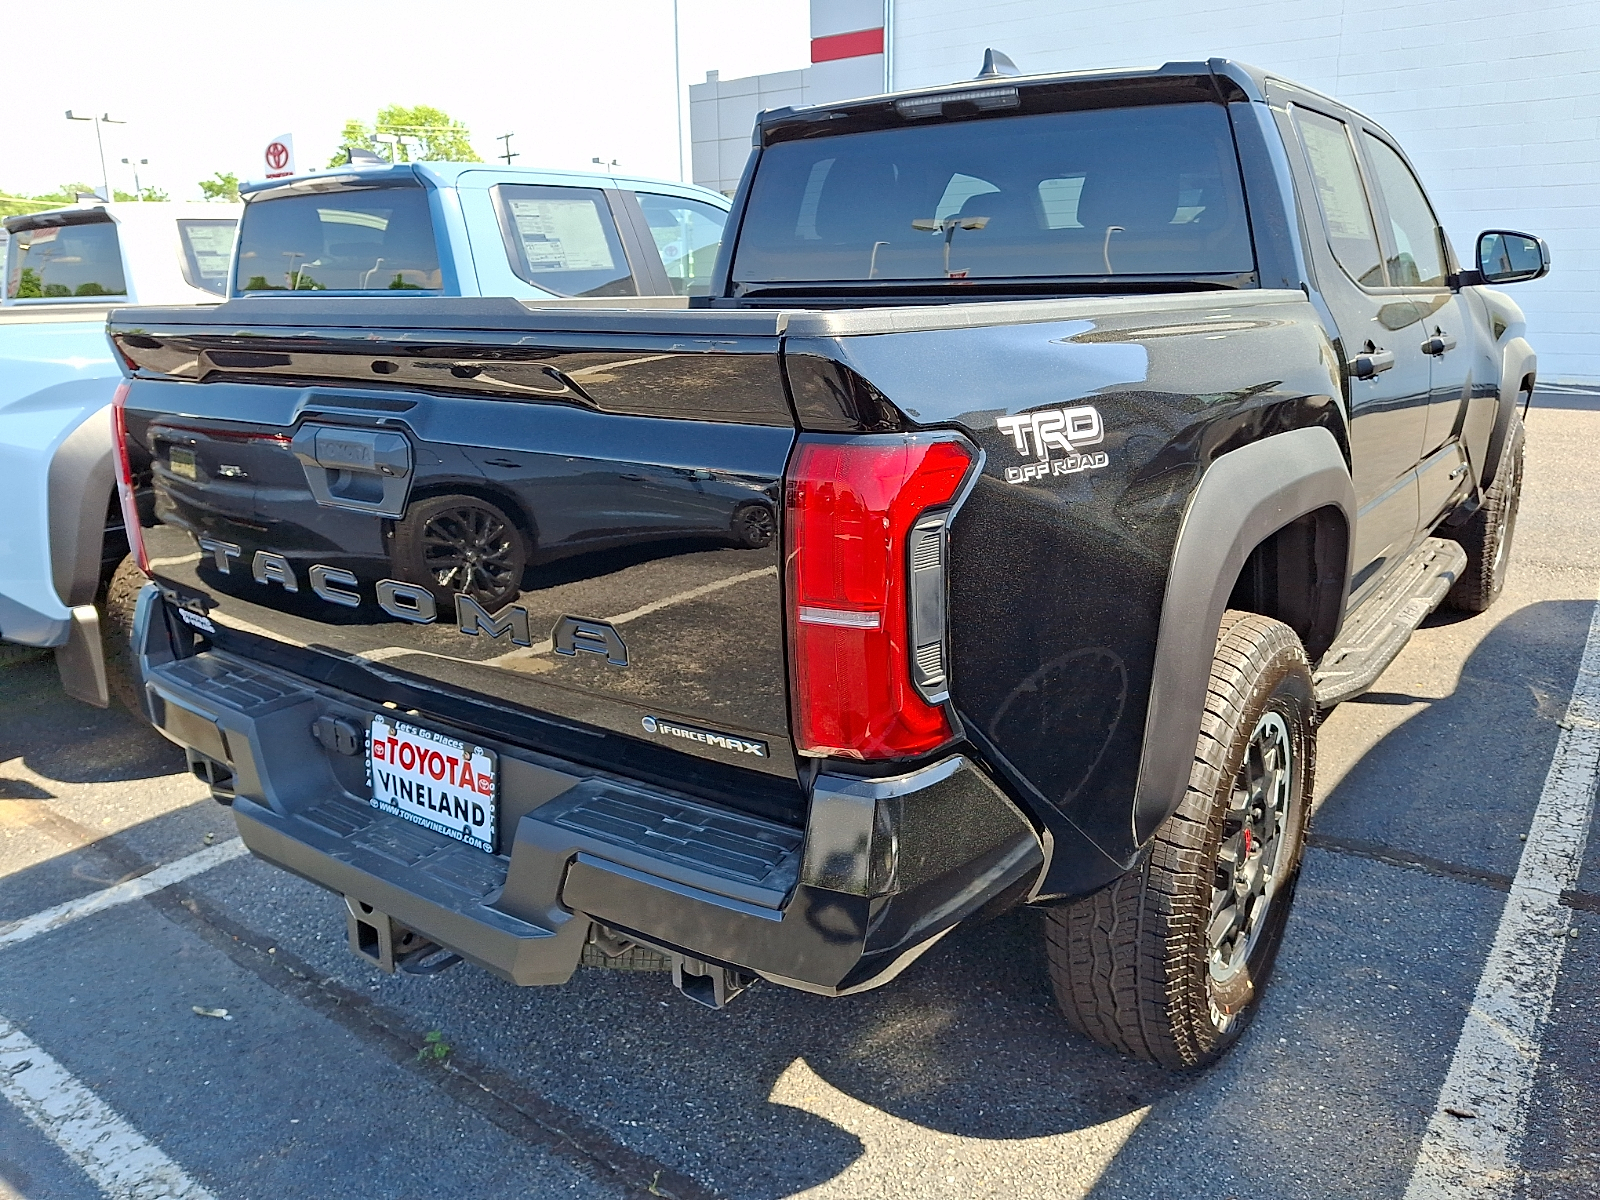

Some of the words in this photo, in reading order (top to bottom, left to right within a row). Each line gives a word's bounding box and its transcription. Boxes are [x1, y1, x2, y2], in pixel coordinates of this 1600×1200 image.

[995, 405, 1104, 462] TRD
[1005, 462, 1050, 484] OFF
[1051, 451, 1109, 477] ROAD
[199, 537, 630, 667] TACOMA
[364, 729, 372, 788] TOYOTA
[395, 720, 418, 736] Let's
[418, 729, 431, 740] Go
[433, 733, 464, 750] Places
[387, 736, 477, 793] TOYOTA
[378, 768, 486, 827] VINELAND
